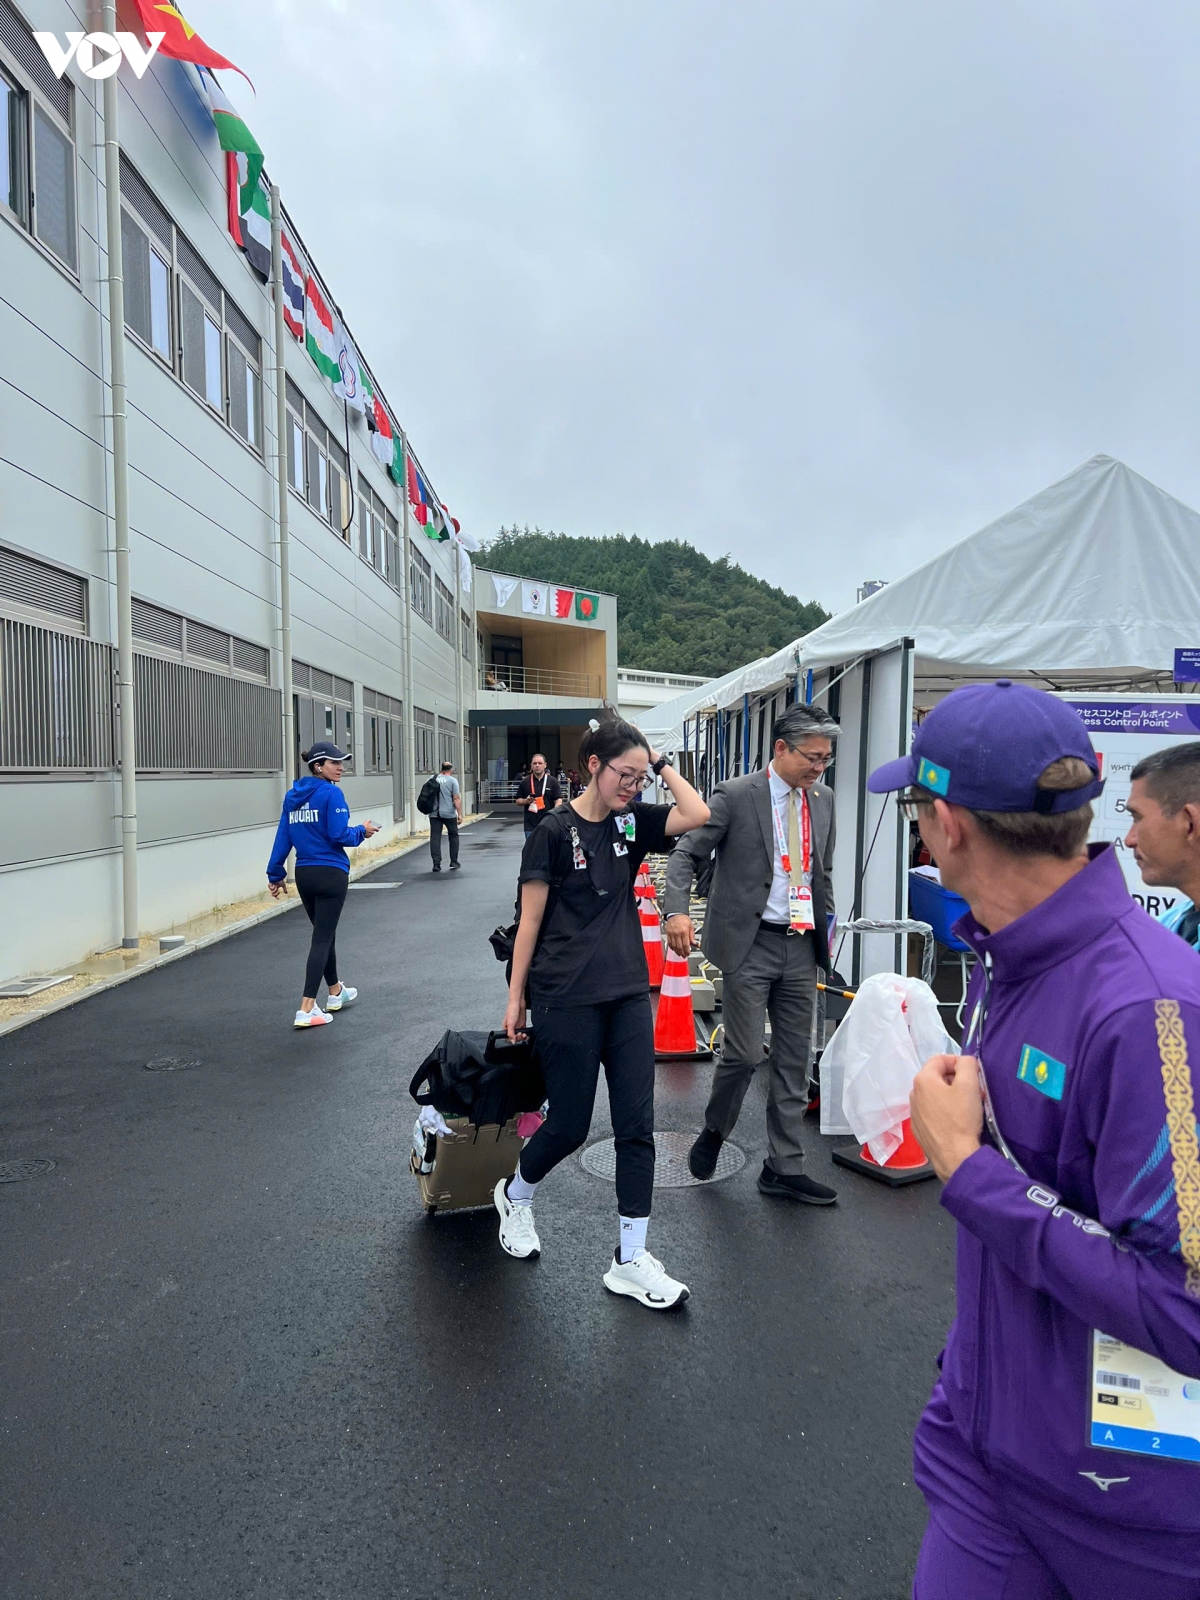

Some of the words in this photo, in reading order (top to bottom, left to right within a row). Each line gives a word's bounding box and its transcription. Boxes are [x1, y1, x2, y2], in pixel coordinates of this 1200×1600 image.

[1103, 717, 1141, 727] Control
[1142, 718, 1170, 728] Point
[289, 809, 319, 825] KUWAIT
[1104, 1429, 1115, 1441] A
[1151, 1437, 1161, 1449] 2
